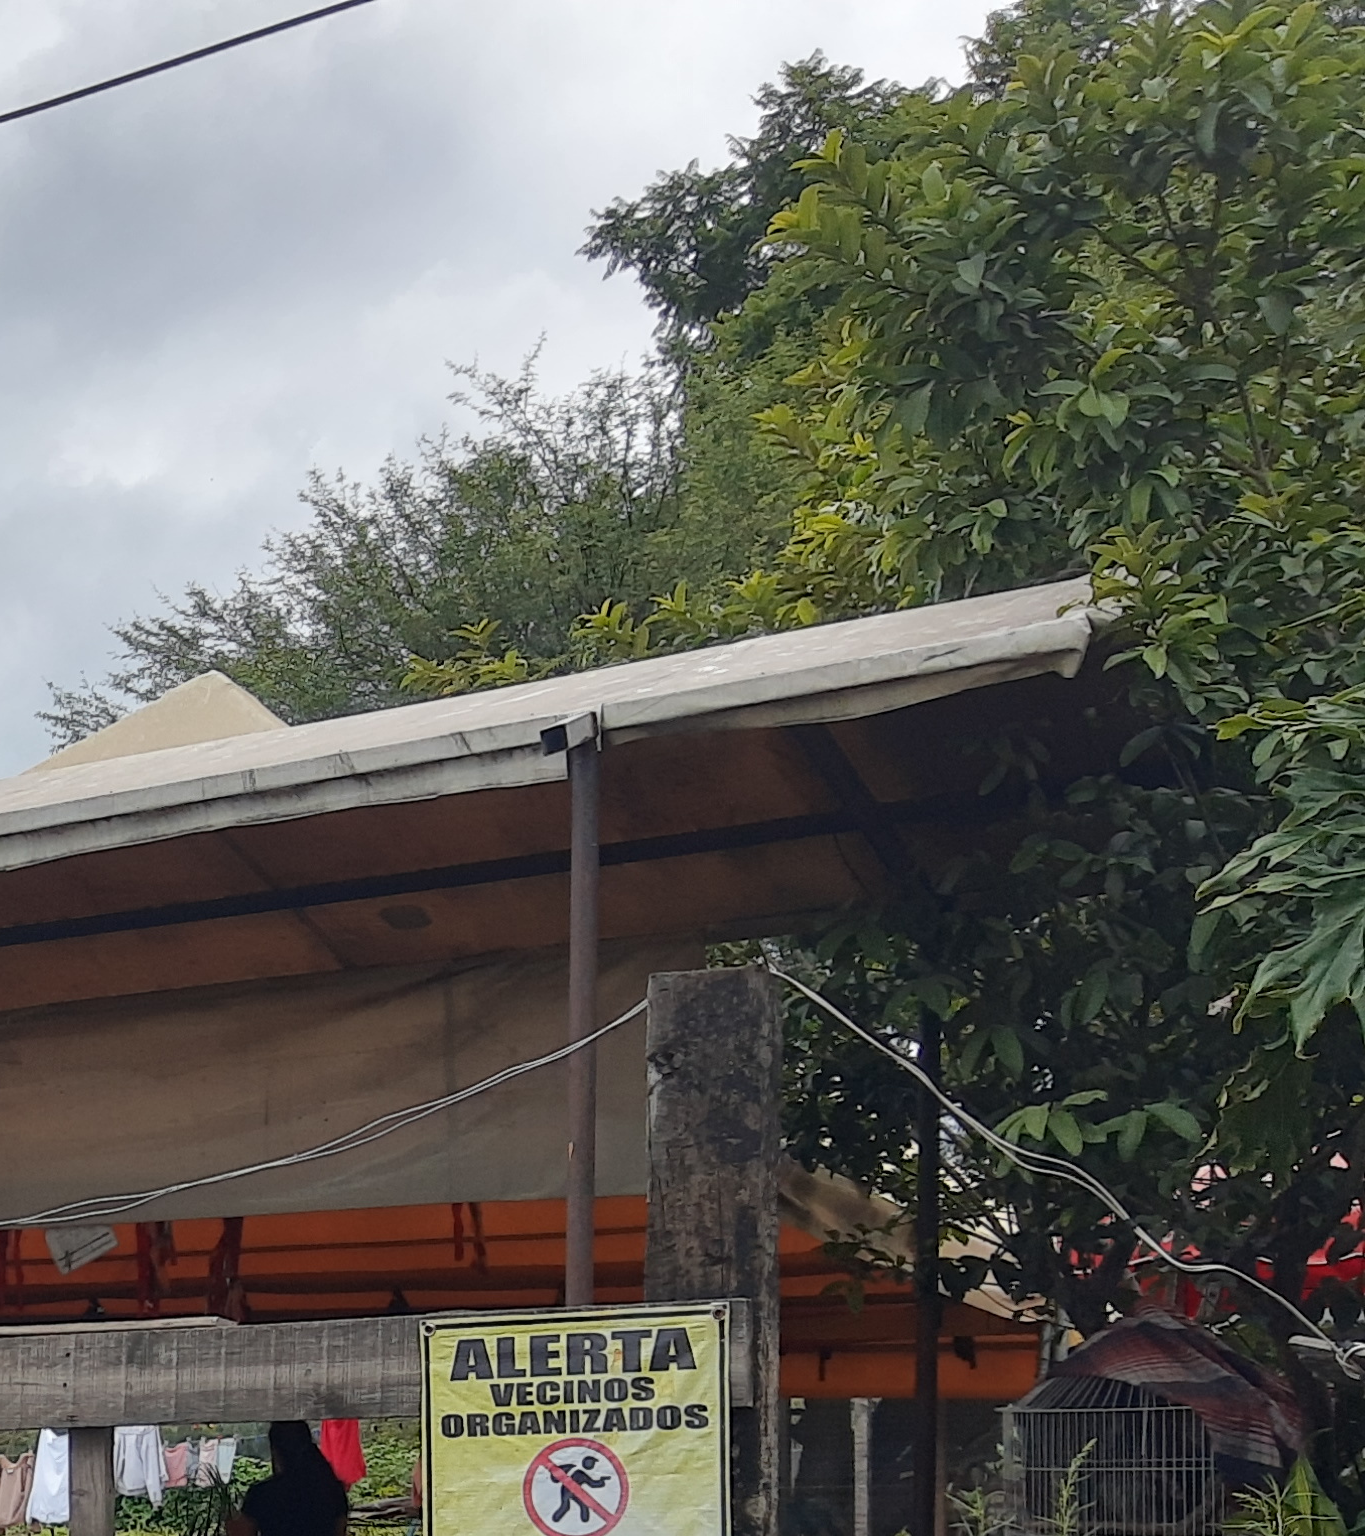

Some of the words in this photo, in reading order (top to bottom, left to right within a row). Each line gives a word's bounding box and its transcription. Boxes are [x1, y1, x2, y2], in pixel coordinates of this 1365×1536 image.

[450, 1327, 697, 1381] ALERTA
[490, 1376, 655, 1407] VECINOS
[441, 1404, 709, 1438] ORGANIZADOS
